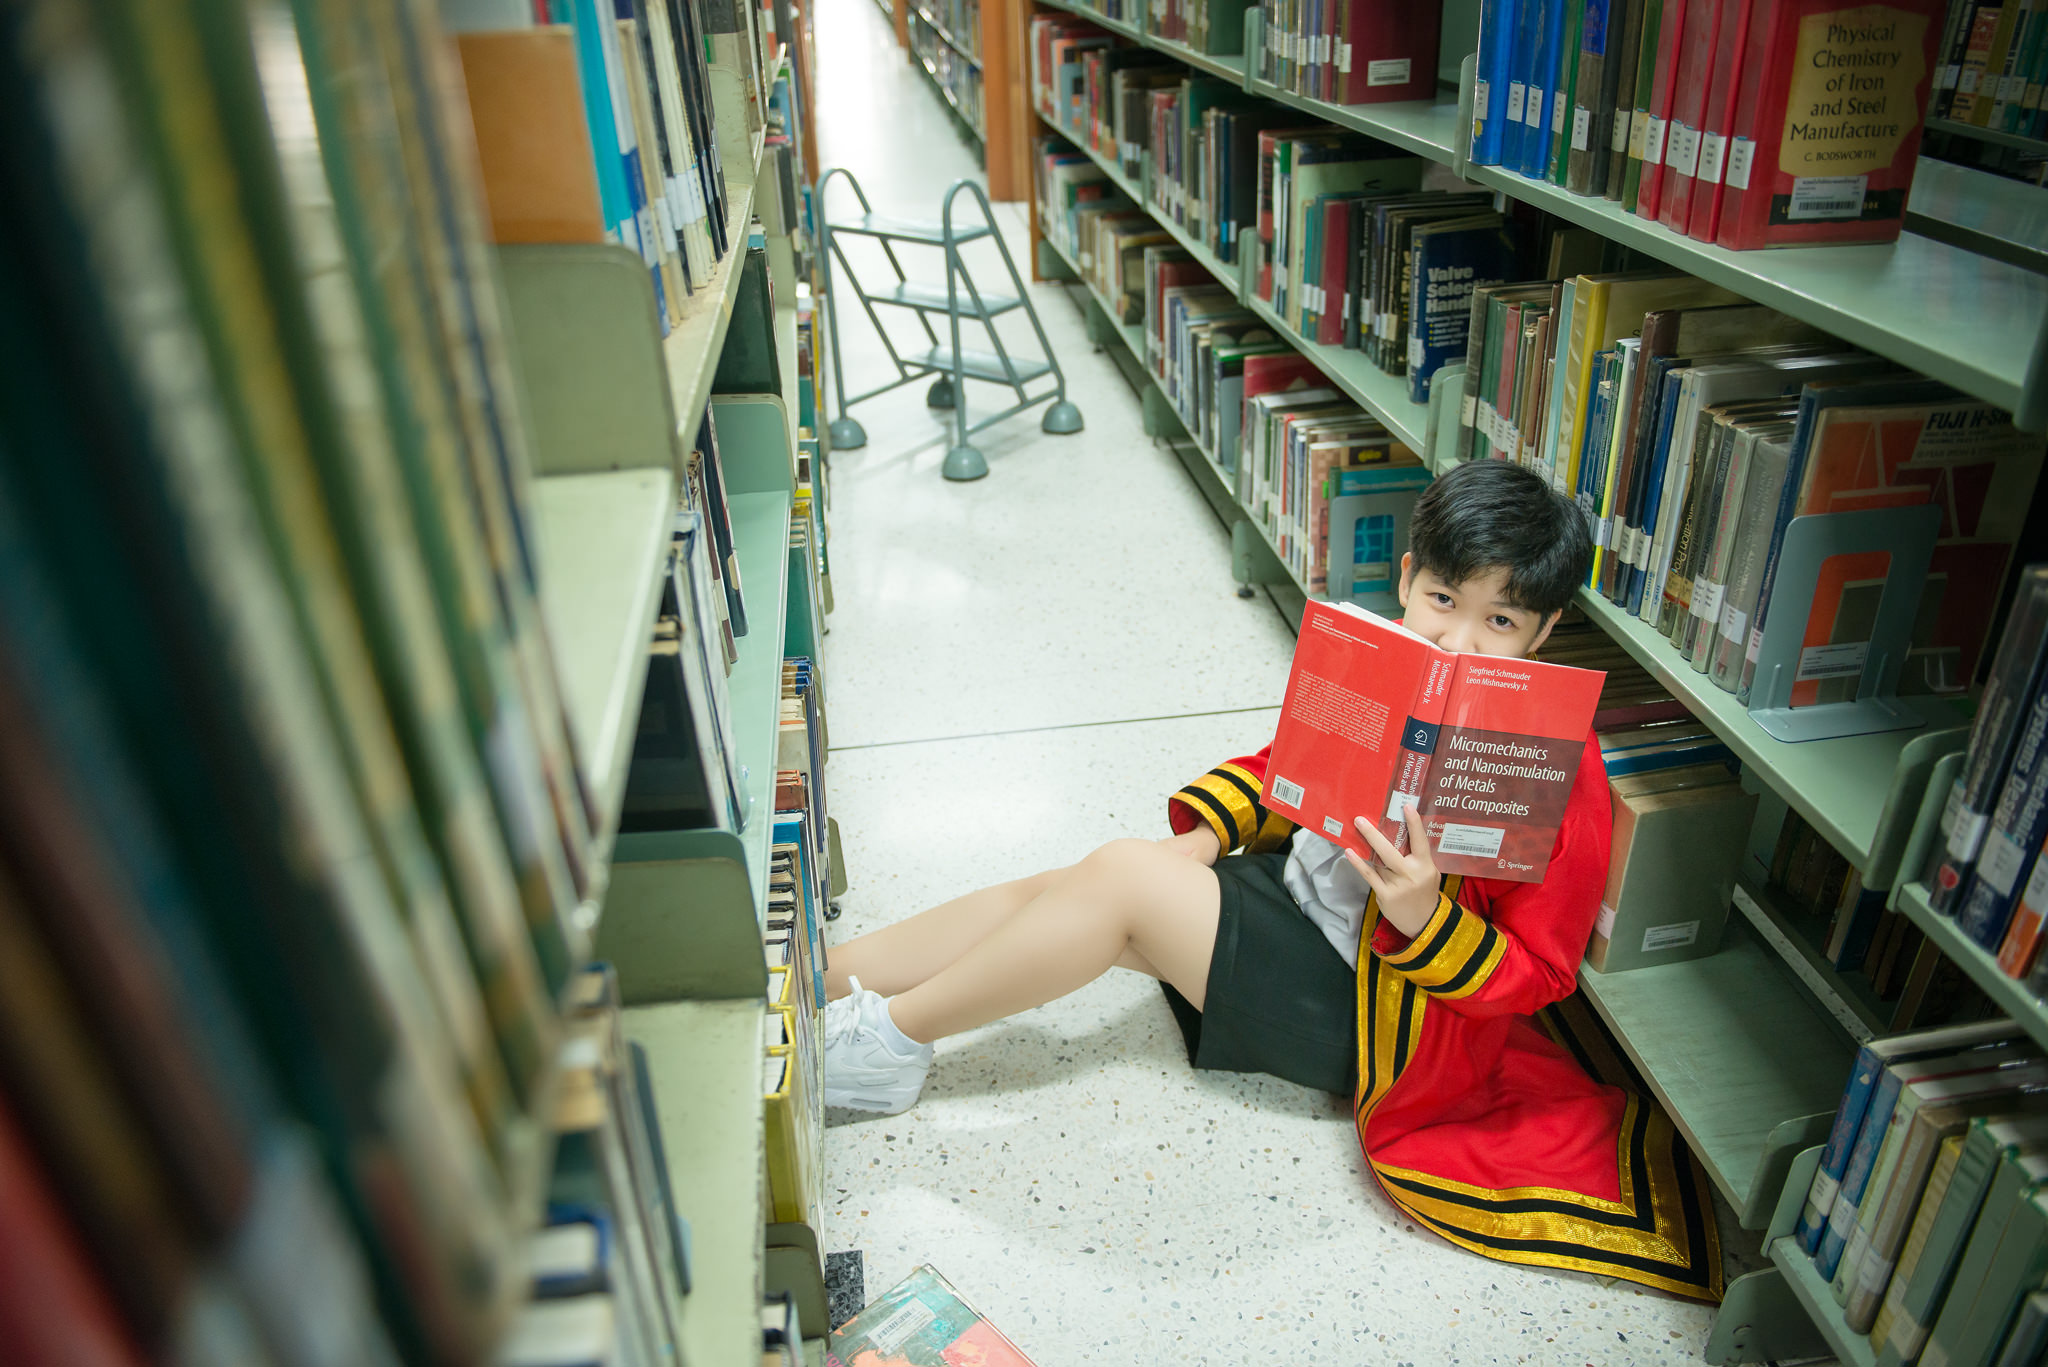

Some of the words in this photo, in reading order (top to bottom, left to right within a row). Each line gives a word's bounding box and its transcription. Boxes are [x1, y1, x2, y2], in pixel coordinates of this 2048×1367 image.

[1826, 23, 1896, 44] Physical
[1812, 49, 1902, 69] Chemistry
[1826, 75, 1844, 92] of
[1849, 74, 1885, 92] Iron
[1810, 99, 1841, 116] and
[1847, 96, 1886, 115] Steel
[1790, 121, 1899, 141] Manufacture
[1816, 150, 1876, 161] BODSWORTH
[1428, 266, 1473, 283] Valve
[1926, 410, 1968, 431] FUJI
[1425, 659, 1441, 699] Mishnaevsky
[1435, 663, 1451, 696] Schmauder
[1469, 665, 1496, 677] Siegfried
[1496, 668, 1531, 681] Schmauder
[1466, 676, 1480, 685] Leon
[1481, 679, 1521, 691] Mishnaevsky
[1521, 683, 1529, 691] Jr.
[1449, 734, 1548, 761] Micromechanics
[1402, 761, 1413, 781] Metals
[1444, 756, 1470, 771] and
[1470, 757, 1566, 782] Nanosimulation
[1439, 774, 1456, 788] of
[1455, 775, 1497, 793] Metals
[1434, 794, 1460, 808] and
[1461, 795, 1530, 816] Composites
[1506, 861, 1534, 872] Springer
